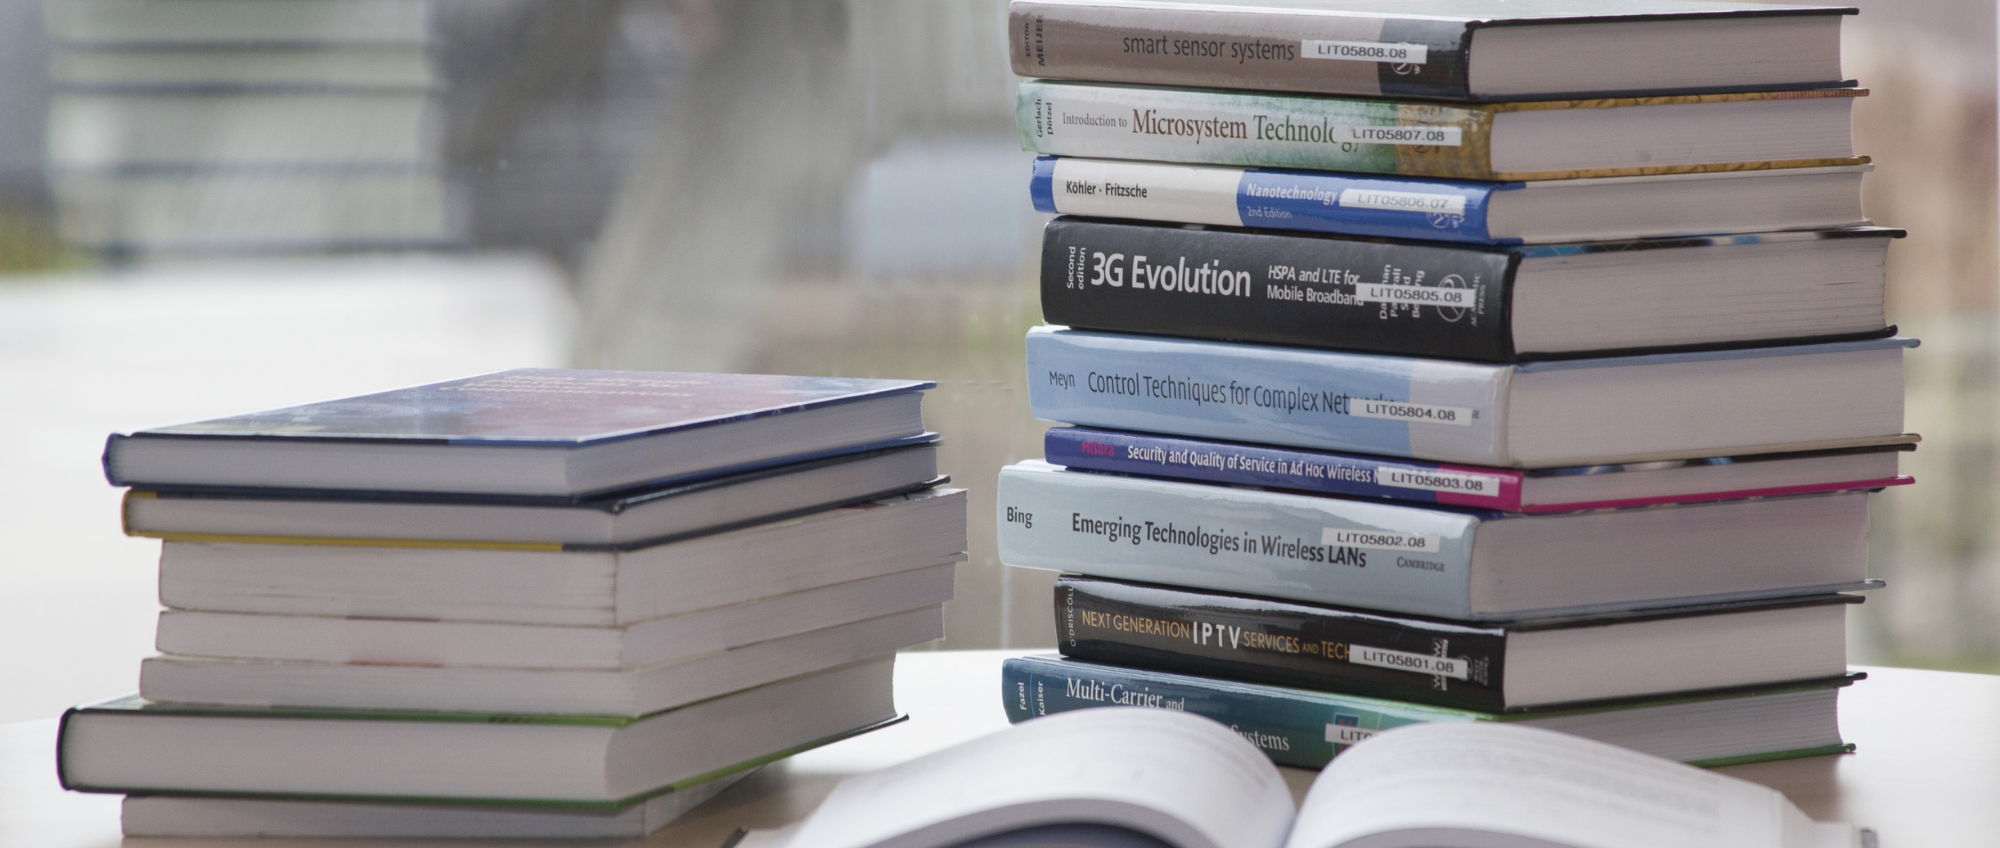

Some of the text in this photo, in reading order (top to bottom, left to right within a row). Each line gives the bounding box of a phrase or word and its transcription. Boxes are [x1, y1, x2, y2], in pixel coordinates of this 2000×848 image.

[1036, 14, 1046, 67] MEIJER
[1123, 35, 1295, 65] smart sensor systems
[1318, 44, 1407, 59] LIT05808.08
[1035, 98, 1043, 139] Gerlach
[1046, 102, 1054, 135] Dötzel
[1062, 109, 1358, 153] Introduction to Microsystem Technol
[1352, 128, 1445, 141] LIT05807.08
[1066, 180, 1148, 198] Köhler Fritzsche
[1246, 183, 1338, 206] Nanotechnology
[1357, 193, 1449, 209] LIT05806.07
[1247, 206, 1292, 219] 2nd Edition
[1066, 246, 1076, 289] Second
[1077, 247, 1086, 290] edition
[1091, 252, 1250, 297] 3G Evolution
[1268, 264, 1360, 285] HSPA and LTE for
[1266, 285, 1304, 301] Mobile
[1370, 287, 1462, 303] LIT05805.08
[1049, 370, 1075, 390] Meyn
[1088, 371, 1140, 396] Control
[1143, 376, 1226, 406] Techniques
[1230, 380, 1251, 406] for
[1254, 385, 1319, 415] Complex
[1366, 403, 1456, 421] LIT05804.08
[1081, 440, 1114, 457] Mishra
[1127, 445, 1166, 465] Security
[1168, 449, 1188, 465] and
[1189, 451, 1226, 471] Quality
[1227, 454, 1238, 470] of
[1239, 456, 1275, 473] Service
[1277, 458, 1288, 474] in
[1290, 461, 1303, 476] Ad
[1305, 464, 1324, 478] Hoc
[1327, 465, 1371, 483] Wireless
[1392, 472, 1483, 491] LIT05803.08
[1006, 506, 1366, 568] Bing Emerging Technologies in Wireless LANs
[1337, 533, 1426, 548] LIT05802.08
[1396, 556, 1445, 573] CAMBRIDGE
[1067, 586, 1077, 648] O'DRISCOLL
[1082, 610, 1111, 628] NEXT
[1113, 614, 1190, 639] GENERATION
[1192, 621, 1241, 649] IPTV
[1243, 631, 1300, 654] SERVICES
[1302, 643, 1319, 654] AND
[1363, 651, 1454, 673] LIT05801.08
[1037, 681, 1046, 716] Kaiser
[1066, 677, 1185, 712] Multi-Carrier and
